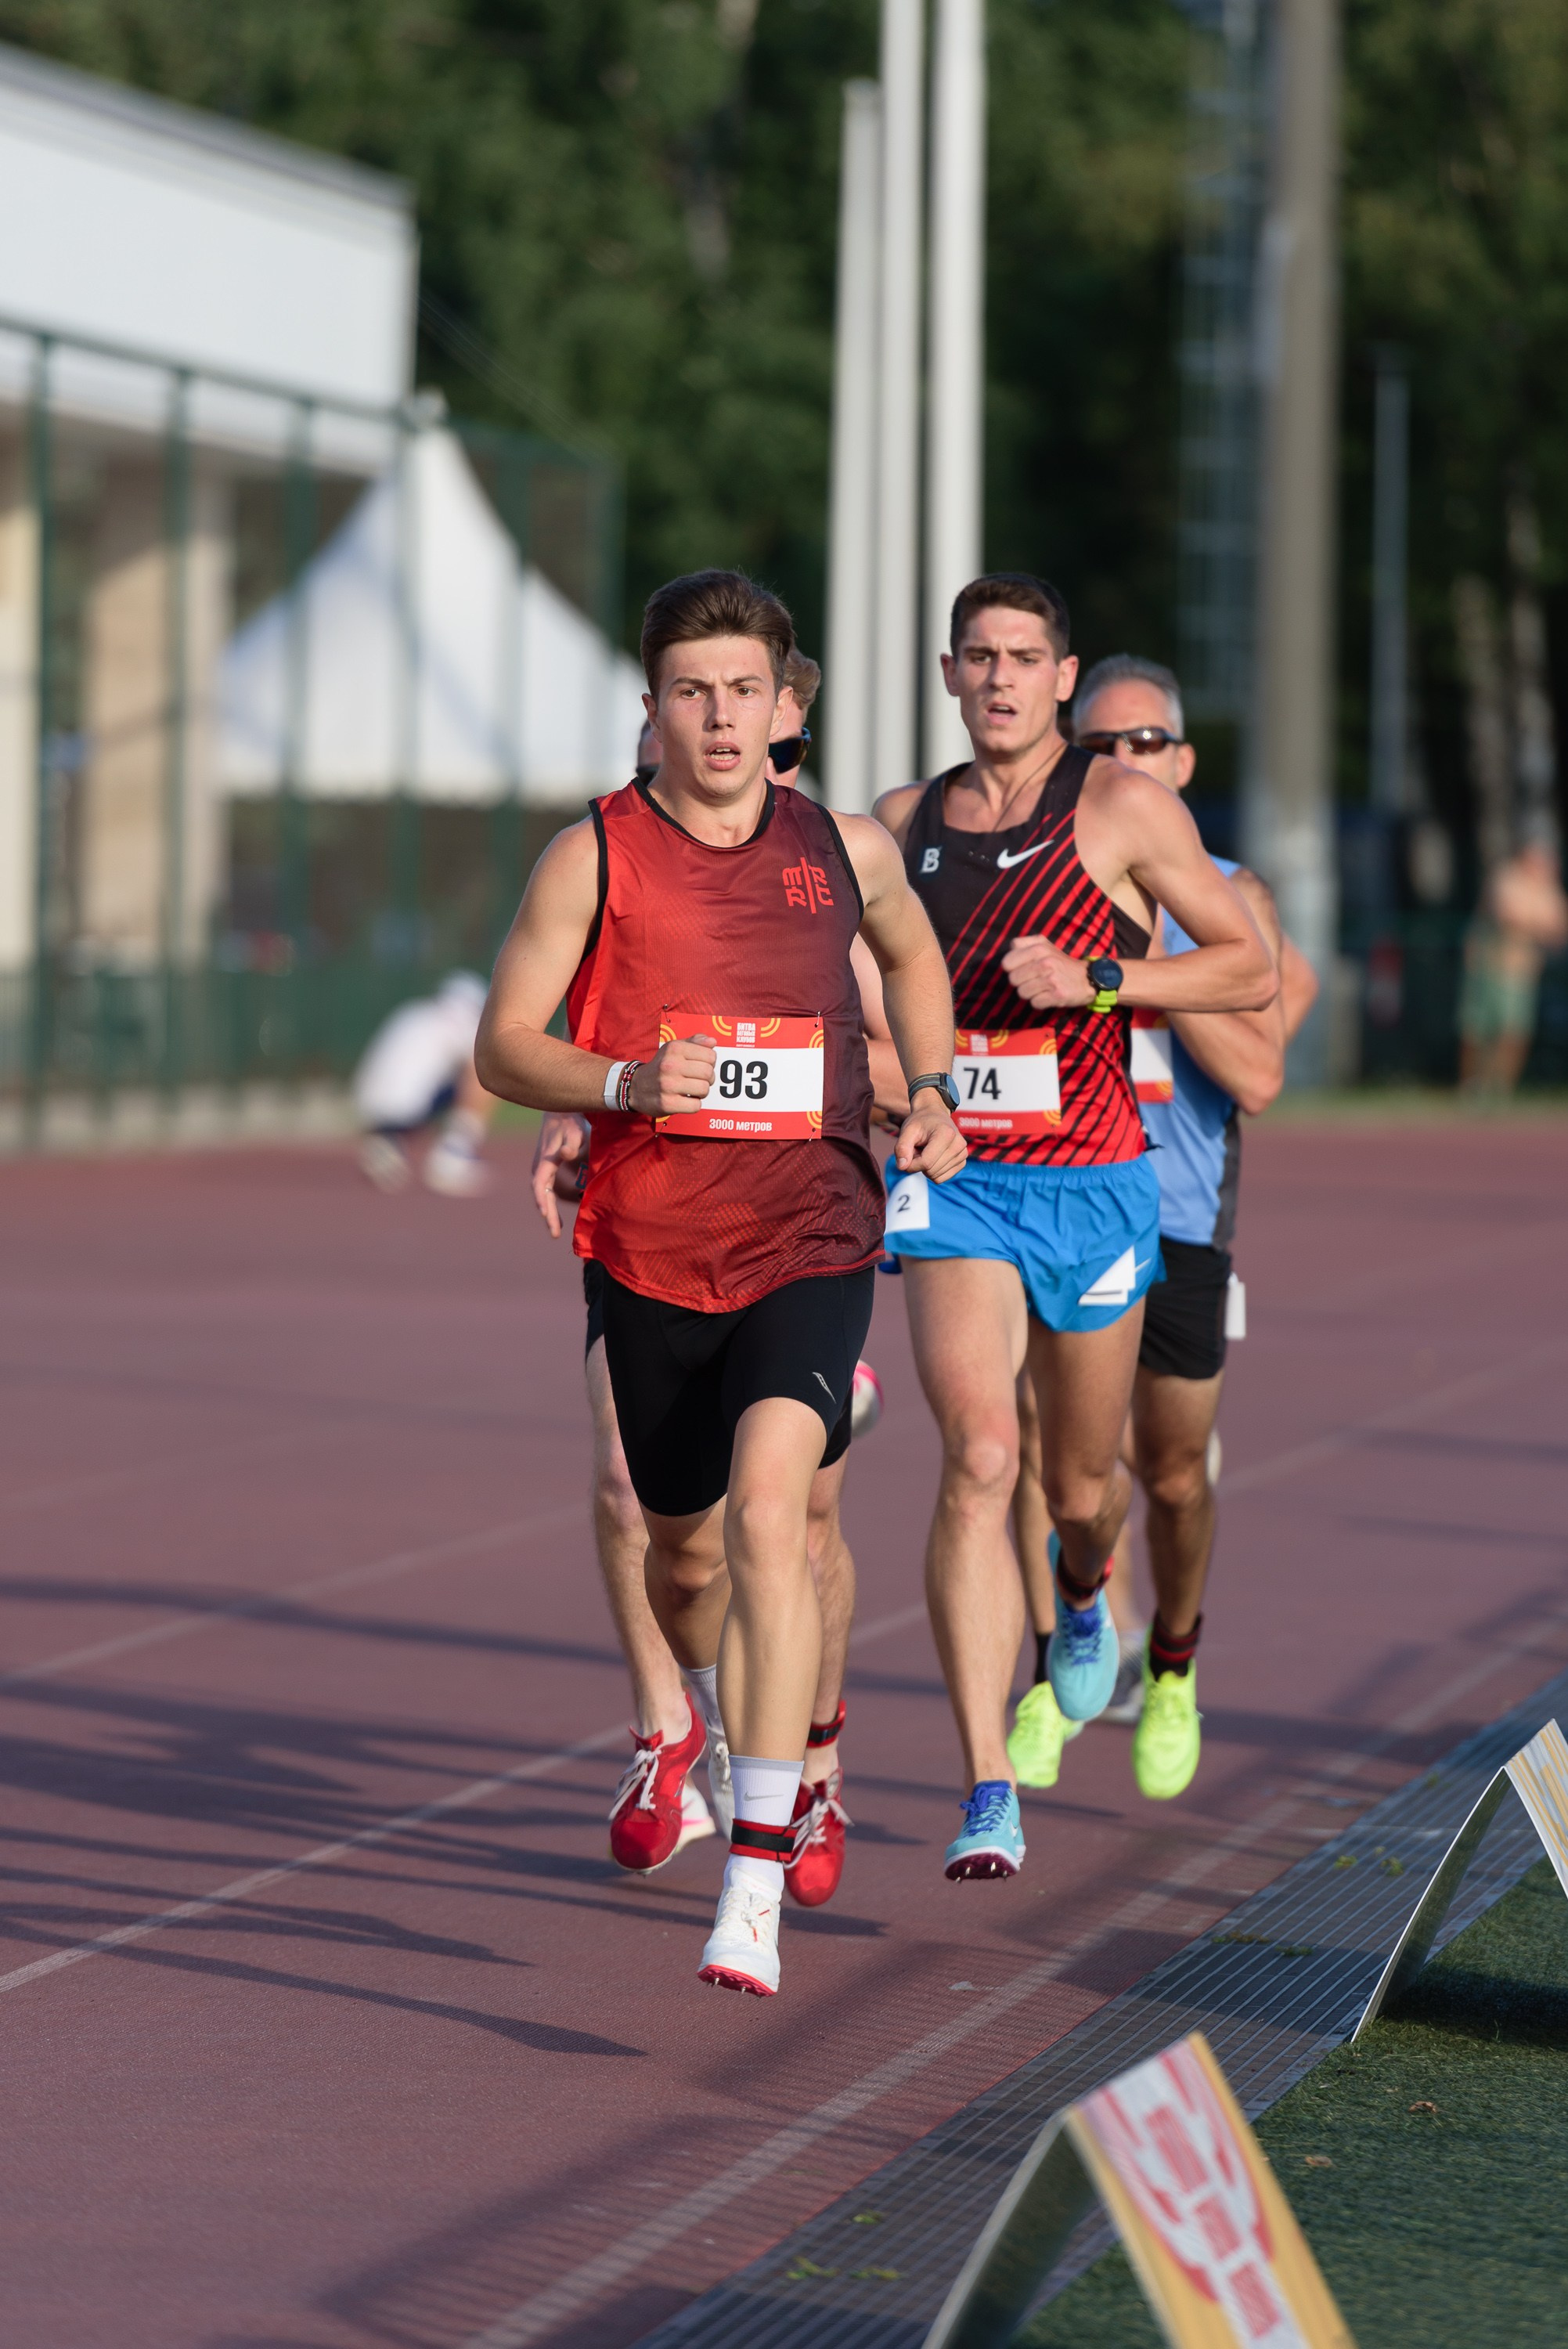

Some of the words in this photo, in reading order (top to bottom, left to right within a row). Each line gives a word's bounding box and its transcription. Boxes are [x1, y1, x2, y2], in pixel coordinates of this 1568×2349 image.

[921, 847, 941, 873] B
[737, 1023, 755, 1031] БИТВА
[719, 1059, 769, 1099] 93
[963, 1066, 1001, 1100] 74
[708, 1118, 734, 1131] 3000
[736, 1121, 773, 1133] метров
[958, 1117, 980, 1128] 3000
[980, 1118, 1013, 1131] метров
[897, 1194, 911, 1213] 2
